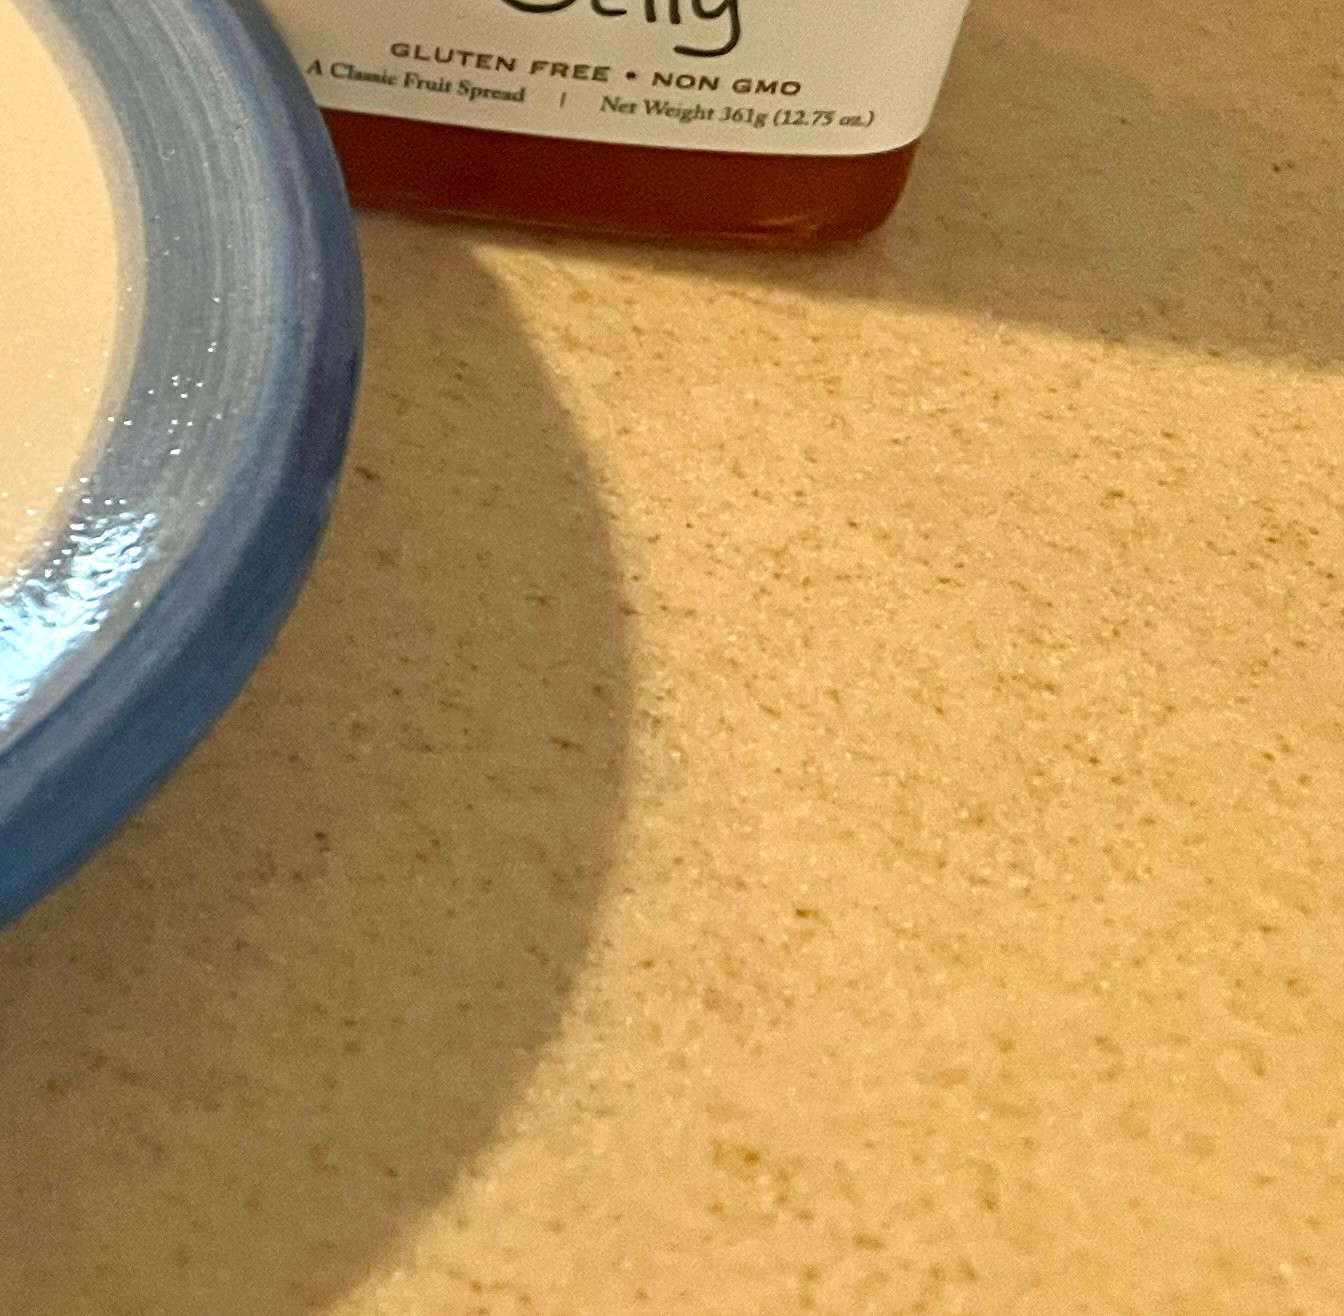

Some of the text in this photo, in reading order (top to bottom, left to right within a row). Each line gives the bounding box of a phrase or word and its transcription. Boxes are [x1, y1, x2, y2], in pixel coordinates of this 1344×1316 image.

[306, 58, 526, 103] A Classic Fruit Spread
[390, 42, 802, 96] GLUTEN FREE NON GMO
[600, 95, 875, 128] Net Weight 361g (12.75 oz.)
